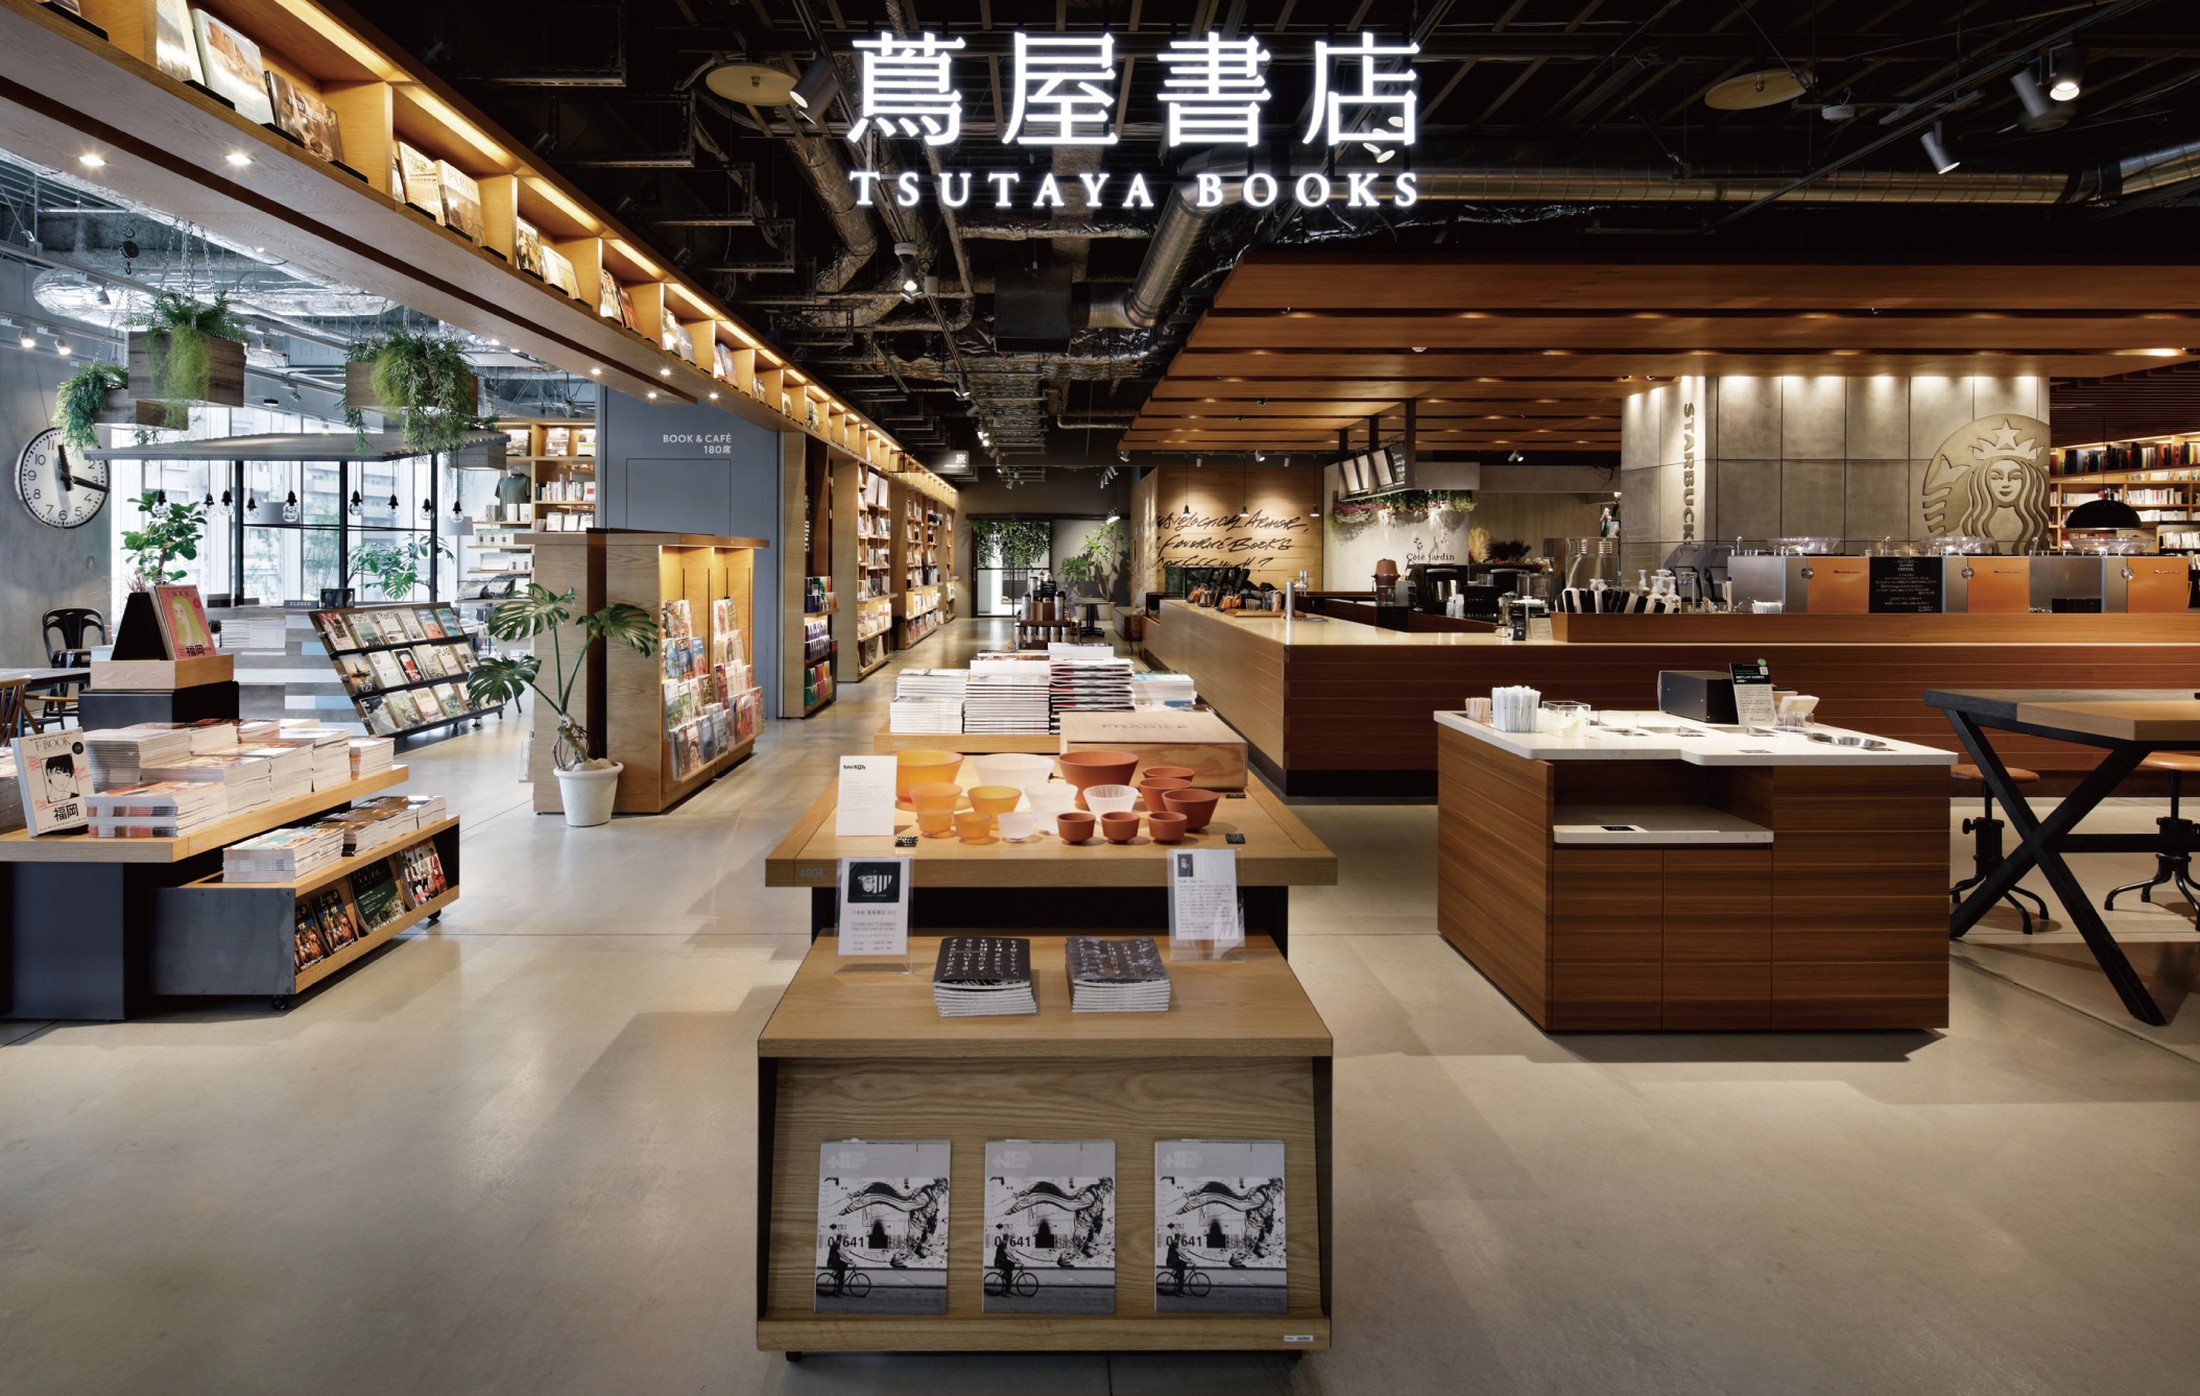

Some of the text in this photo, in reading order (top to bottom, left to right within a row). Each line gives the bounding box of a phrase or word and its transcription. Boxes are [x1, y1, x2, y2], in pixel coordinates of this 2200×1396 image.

[847, 31, 1420, 147] 蔦屋書店
[849, 171, 1418, 208] TSUTAYA BOOKS
[662, 432, 732, 443] BOOK & CAFÉ
[47, 440, 55, 450] 11
[703, 445, 732, 454] 180席
[34, 454, 46, 466] 10
[87, 459, 97, 470] 2
[27, 470, 37, 481] 9
[1683, 402, 1695, 545] STARBUCK
[32, 488, 42, 500] 8
[83, 493, 93, 503] 4
[45, 504, 54, 514] 7
[74, 506, 83, 517] 5
[58, 510, 68, 521] 6
[53, 803, 79, 822] 福岡
